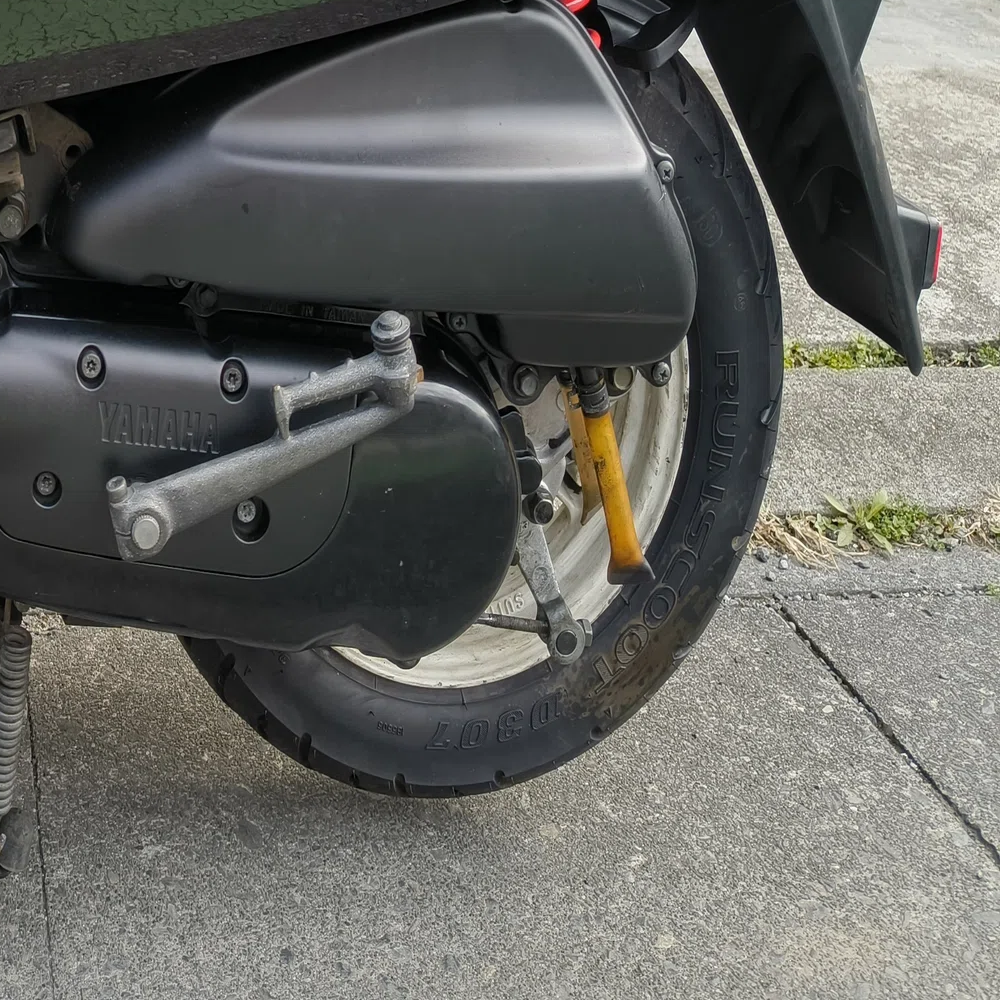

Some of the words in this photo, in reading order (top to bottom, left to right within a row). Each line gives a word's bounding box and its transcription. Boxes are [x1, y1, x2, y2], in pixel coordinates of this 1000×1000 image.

[300, 304, 314, 318] IN
[98, 400, 221, 455] YAMAHA
[425, 689, 568, 751] D307
